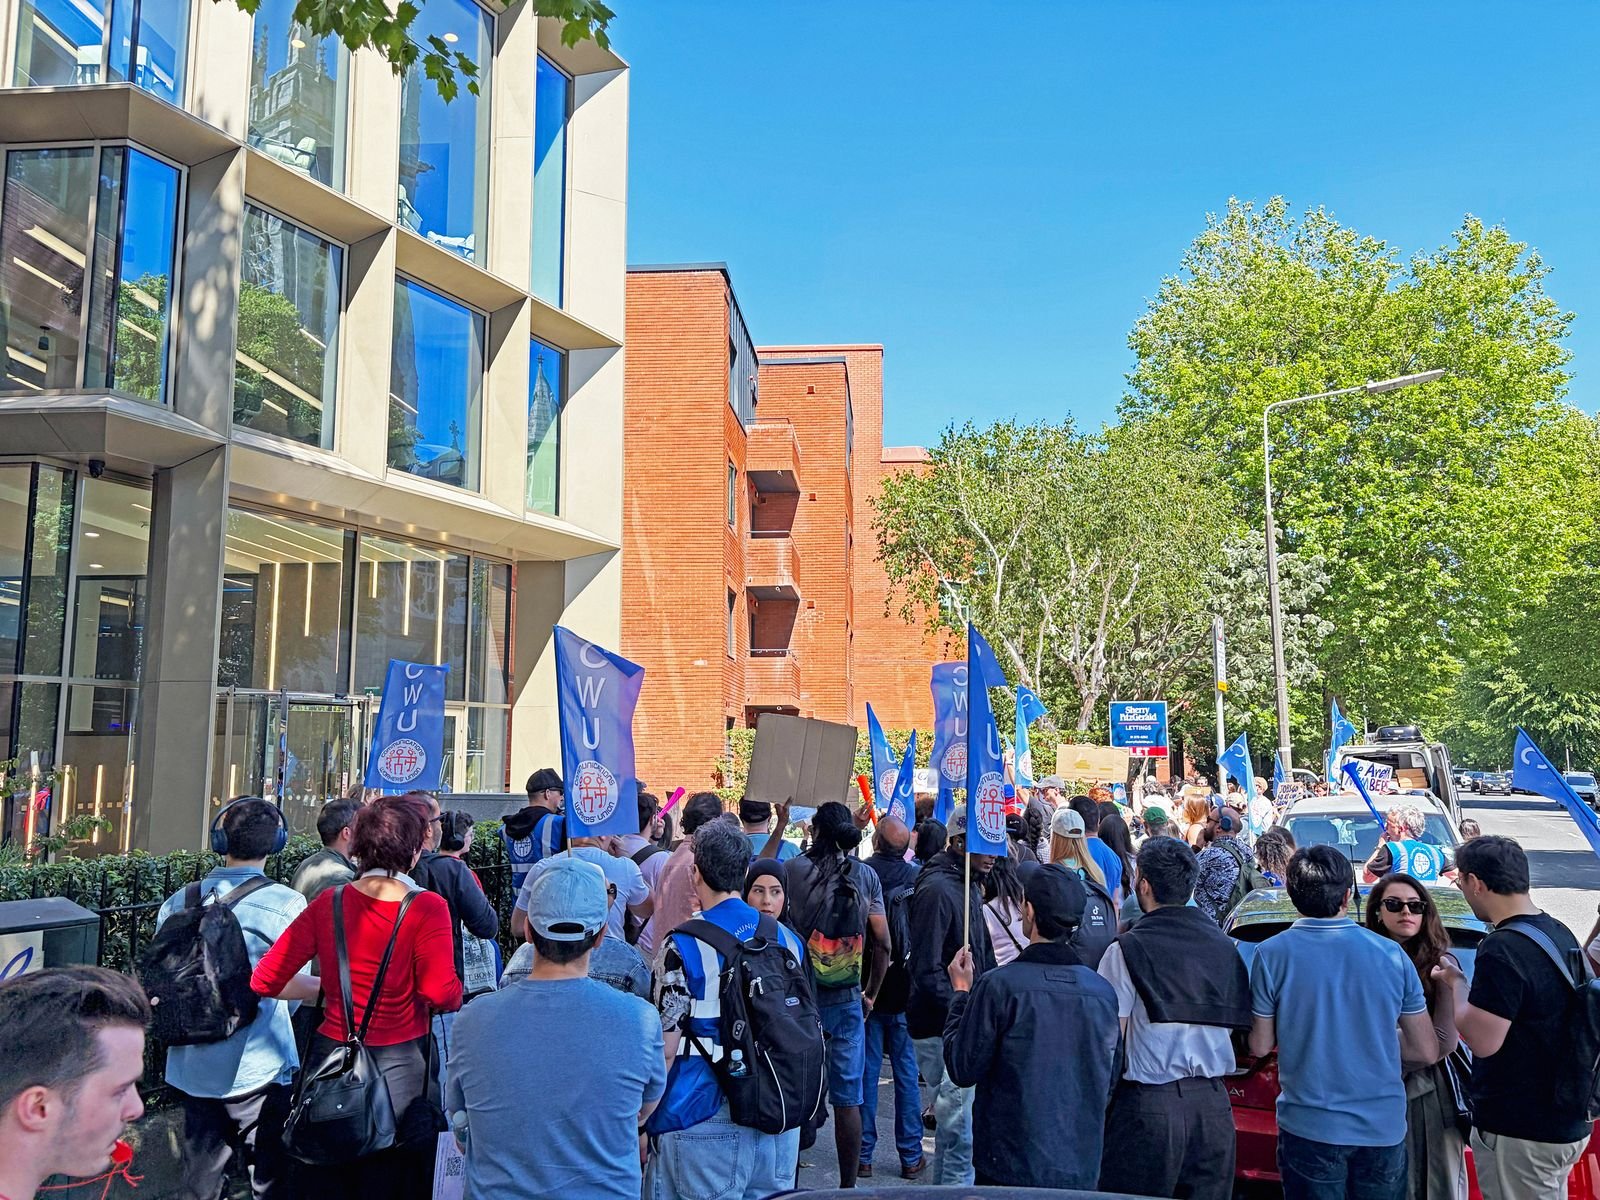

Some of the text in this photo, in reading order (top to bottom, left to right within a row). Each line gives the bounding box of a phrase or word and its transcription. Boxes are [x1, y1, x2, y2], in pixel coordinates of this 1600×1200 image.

[397, 663, 423, 732] CWU
[575, 643, 609, 750] CWU
[1125, 706, 1150, 715] Sherry
[381, 739, 425, 758] COMMUNICATIONS
[1130, 747, 1150, 756] LET
[1229, 1086, 1245, 1098] A1
